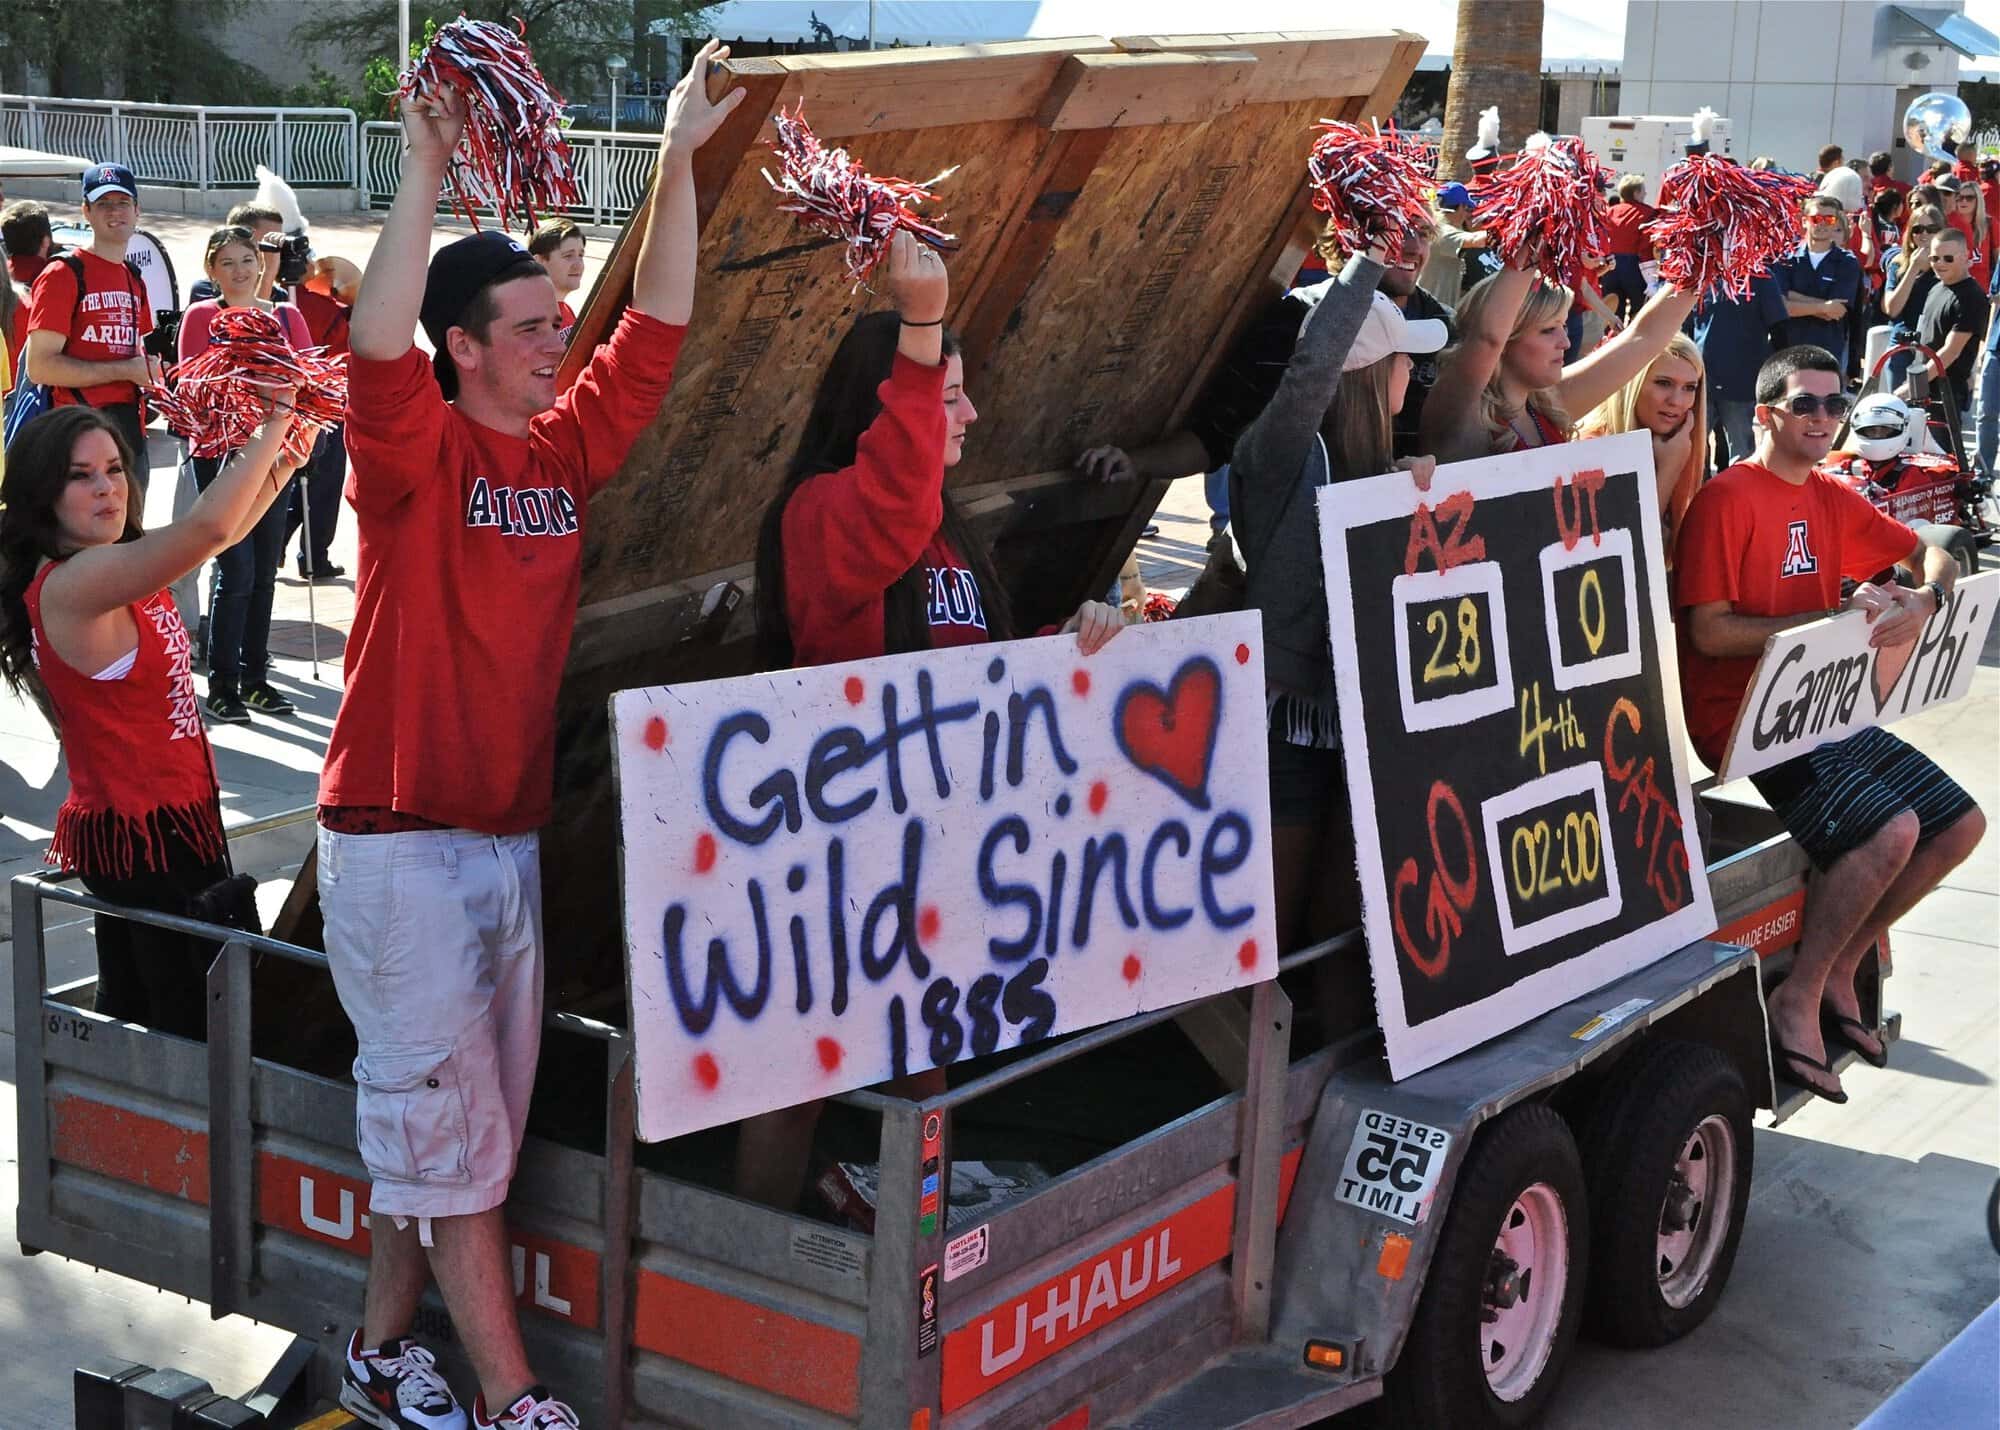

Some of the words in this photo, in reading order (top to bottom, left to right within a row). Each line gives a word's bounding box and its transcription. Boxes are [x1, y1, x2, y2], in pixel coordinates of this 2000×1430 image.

[81, 292, 102, 313] THE
[1405, 490, 1486, 577] AZ
[1553, 468, 1605, 551] UT
[1781, 520, 1817, 578] A
[1935, 510, 1955, 524] SKF
[1424, 598, 1480, 684] 28
[1578, 569, 1606, 656] 0
[1752, 643, 1869, 751] Gamma
[1900, 588, 1978, 714] Phi
[703, 657, 1078, 846] Gettin
[1519, 680, 1586, 775] 4th
[1603, 696, 1690, 914] CATS
[976, 791, 1255, 964] Since
[1393, 779, 1478, 978] GO
[1511, 811, 1601, 901] 02:00
[1736, 925, 1763, 949] MADE
[1763, 910, 1797, 942] EASIER
[889, 957, 1057, 1080] 1885
[950, 1232, 979, 1252] HOTLINE
[980, 1227, 1182, 1377] U-HAUL
